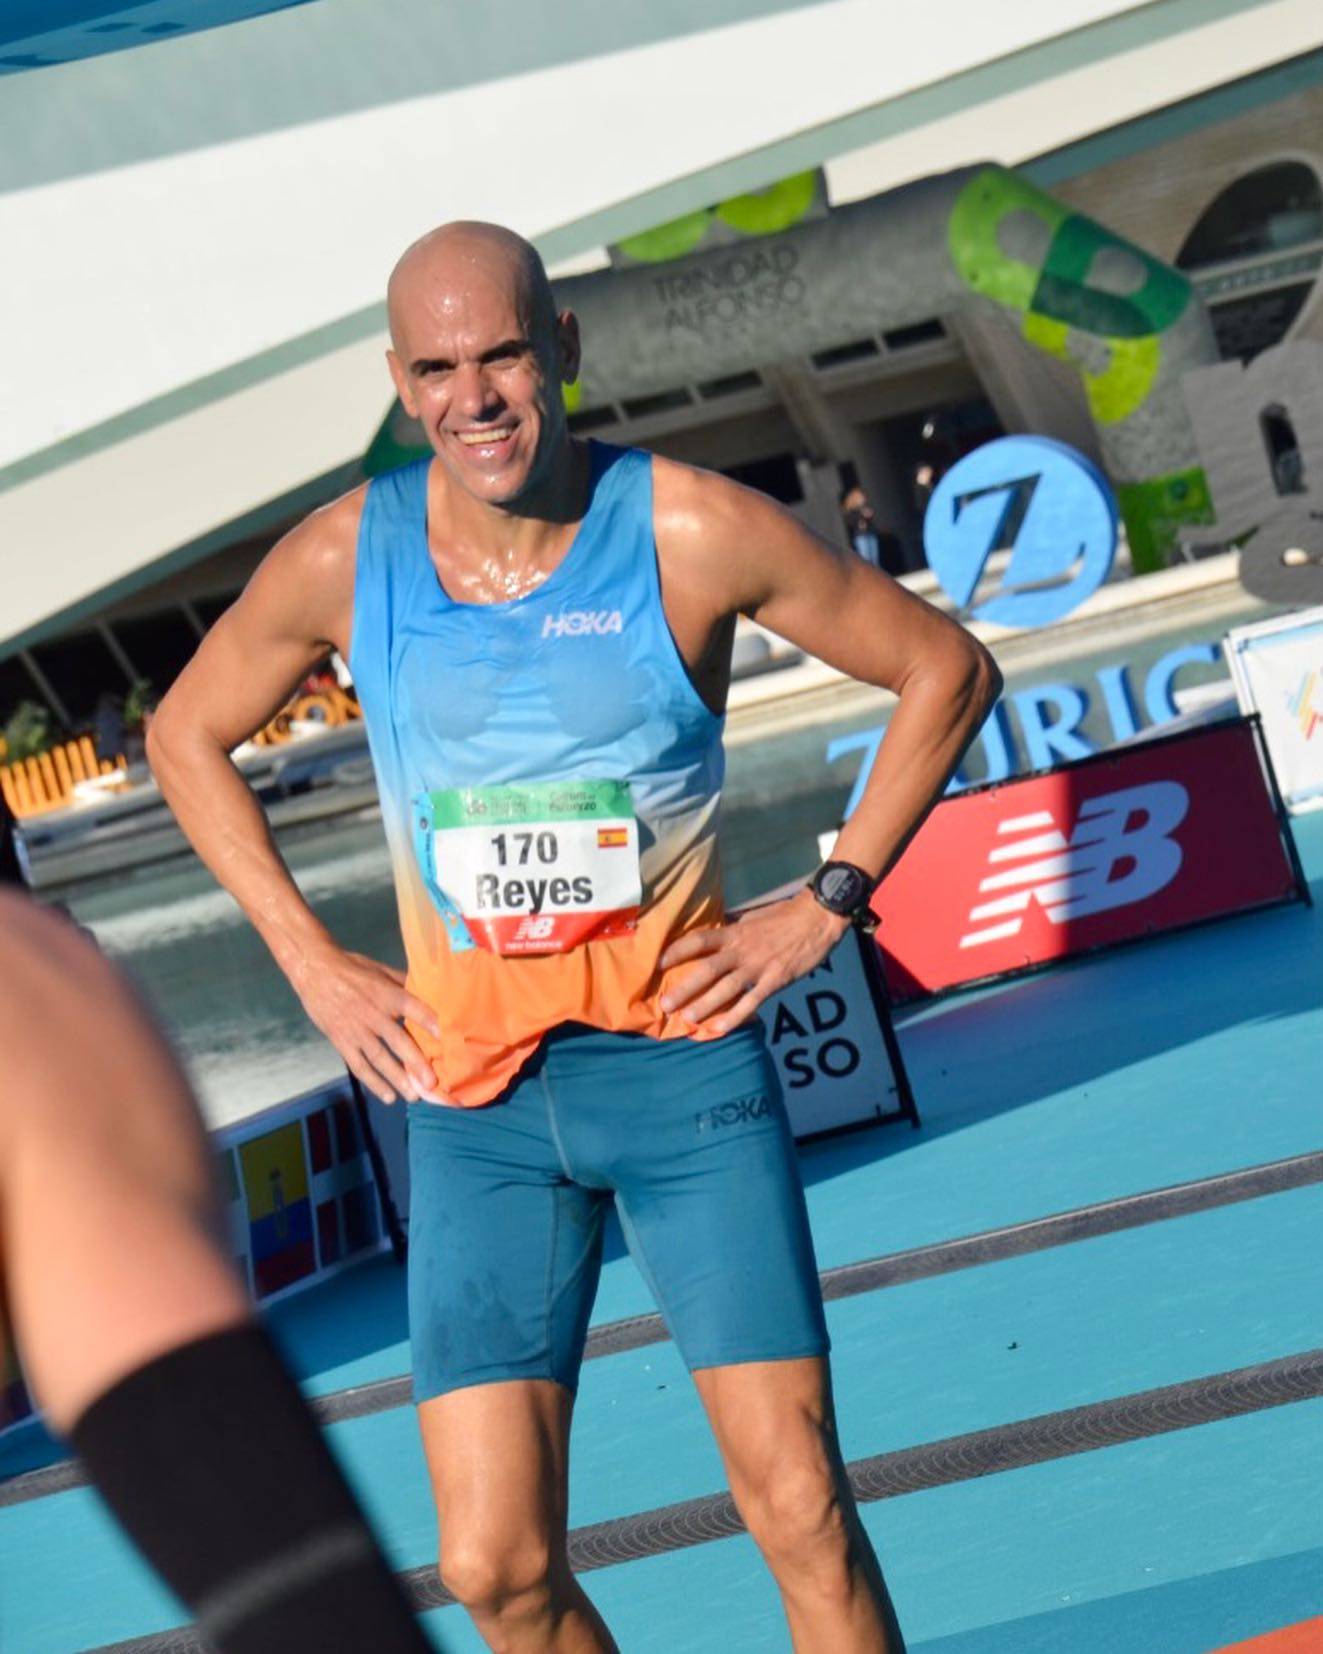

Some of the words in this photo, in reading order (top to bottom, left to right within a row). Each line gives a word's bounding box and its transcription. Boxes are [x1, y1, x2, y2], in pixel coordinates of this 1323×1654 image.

[541, 611, 622, 638] HOKA
[491, 831, 558, 866] 170
[959, 780, 1189, 948] NB
[476, 873, 593, 916] Reyes
[771, 989, 847, 1045] AD
[784, 1037, 860, 1088] SO
